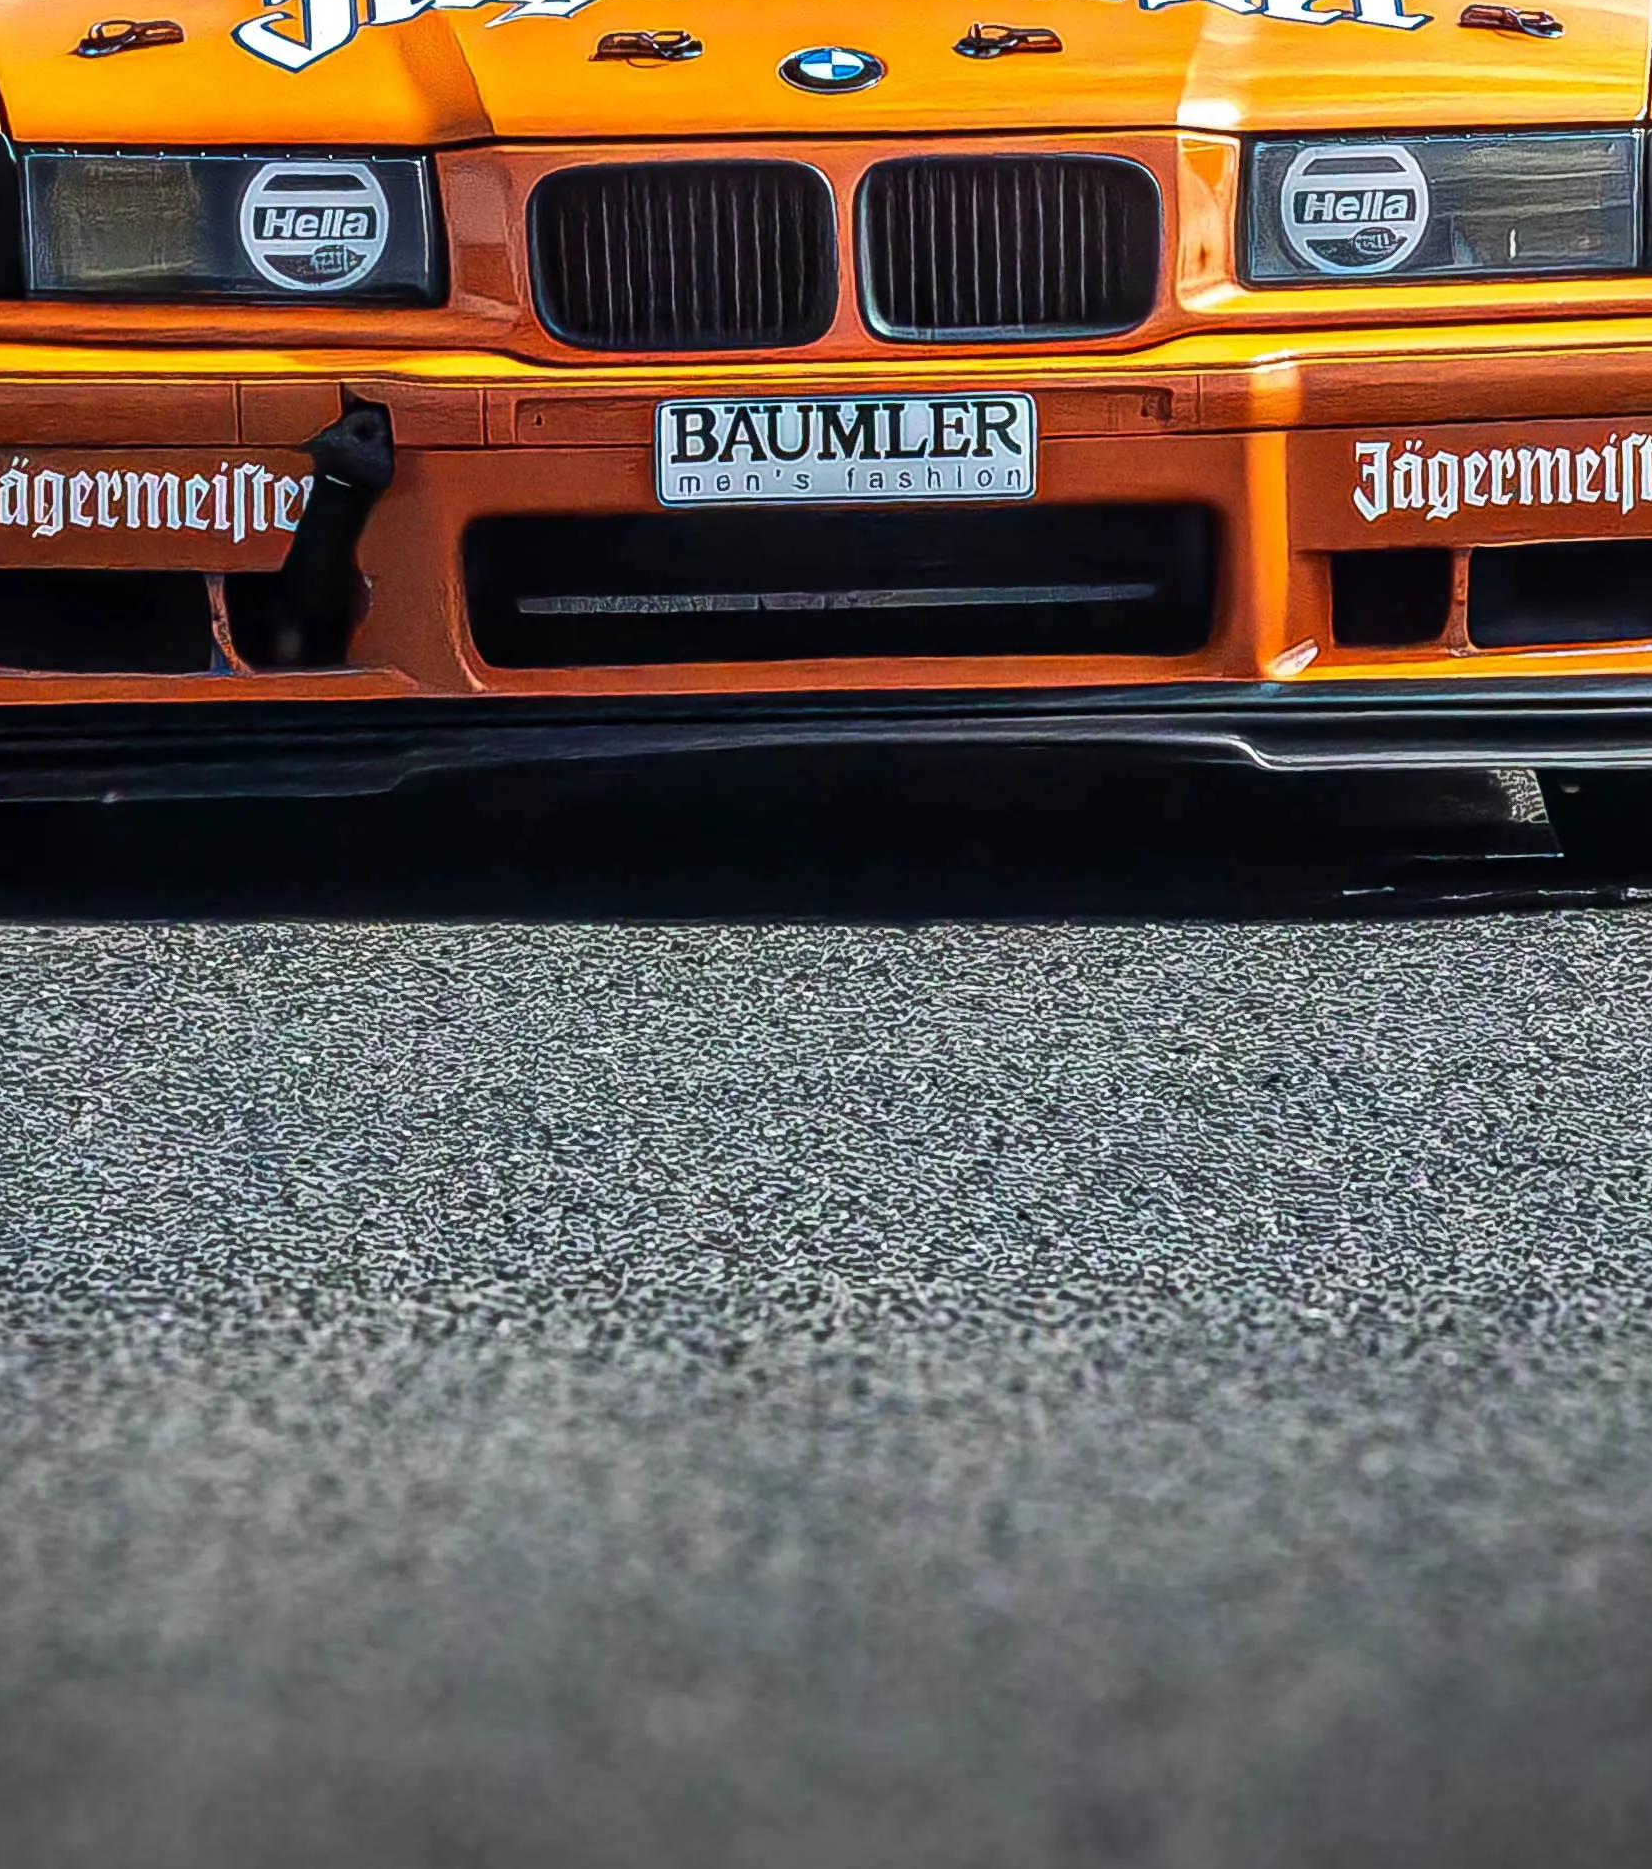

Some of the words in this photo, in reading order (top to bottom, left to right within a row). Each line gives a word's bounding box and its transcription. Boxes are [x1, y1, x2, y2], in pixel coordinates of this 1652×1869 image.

[1303, 190, 1409, 222] Hella
[262, 207, 370, 238] Hella
[669, 400, 1023, 465] BÄUMLER
[678, 468, 812, 495] men's
[847, 464, 1024, 492] fashion
